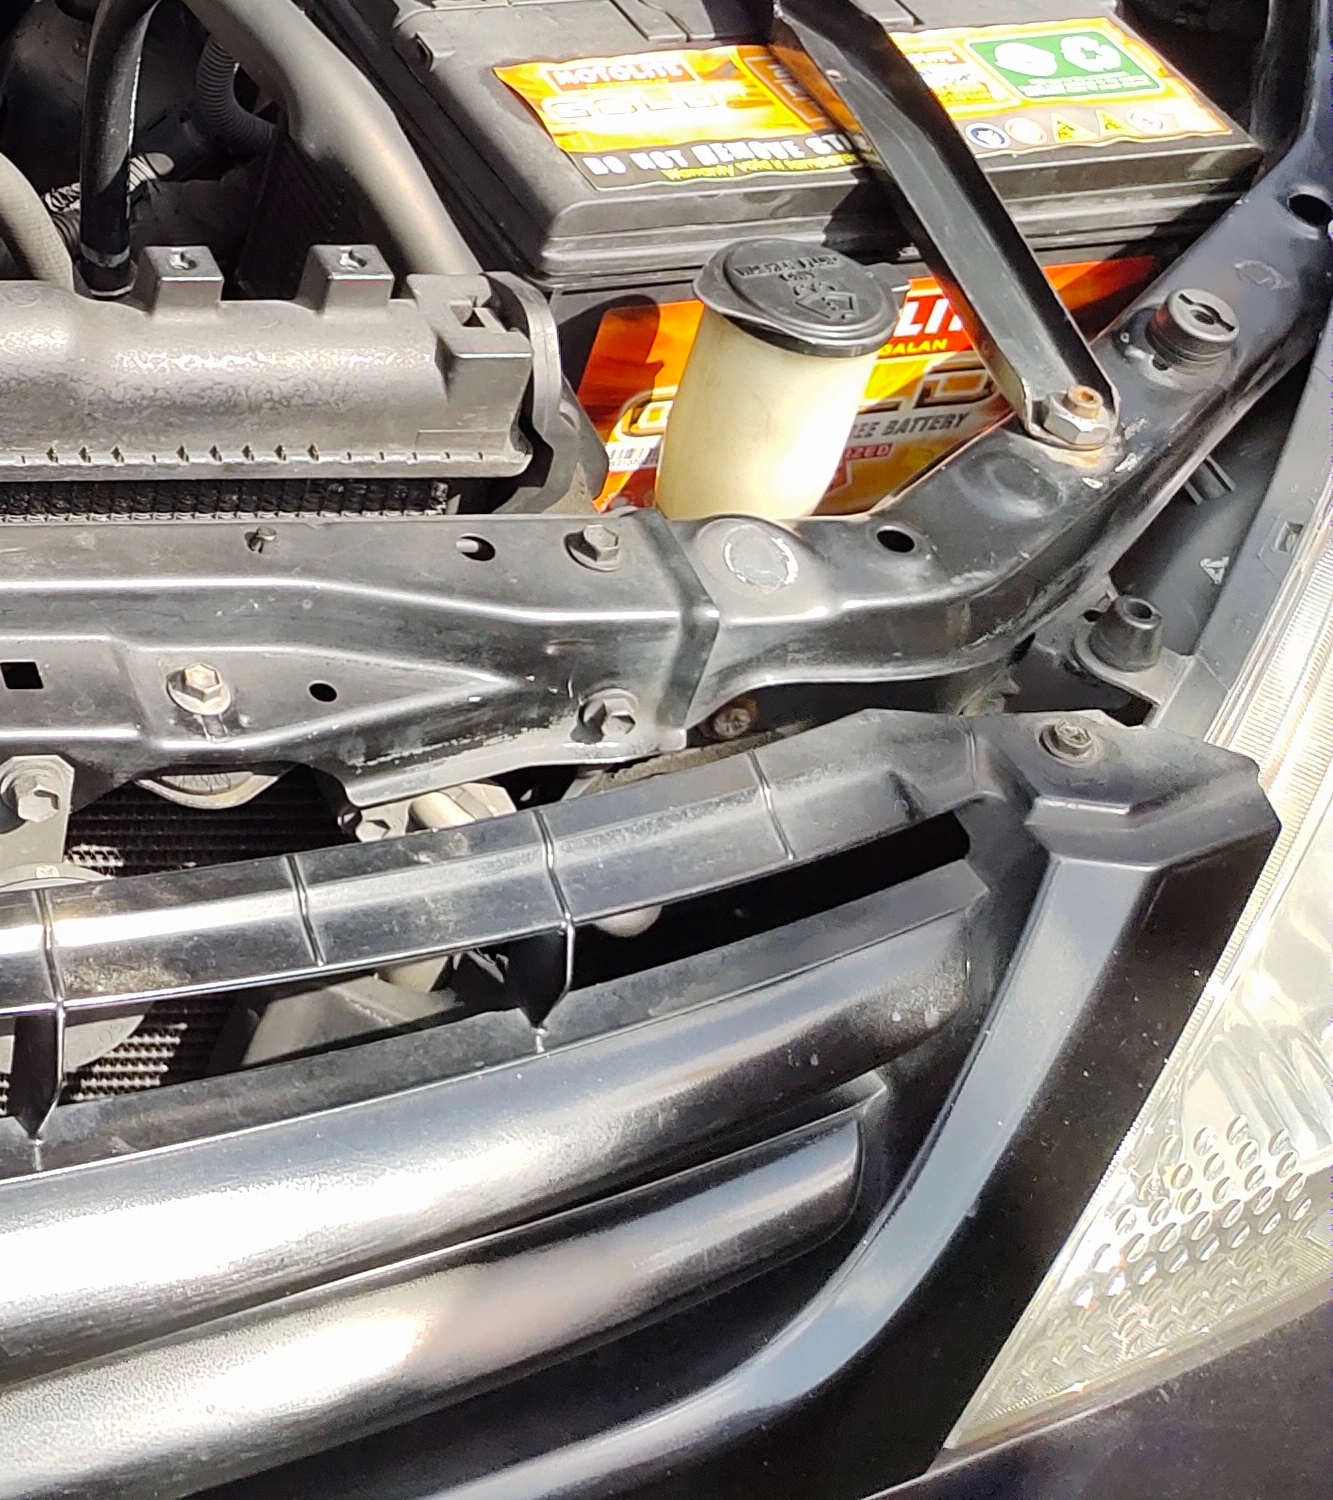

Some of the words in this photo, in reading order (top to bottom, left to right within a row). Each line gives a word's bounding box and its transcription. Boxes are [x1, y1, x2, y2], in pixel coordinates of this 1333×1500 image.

[556, 61, 684, 86] MOTOLITE
[582, 156, 626, 176] DO
[630, 149, 688, 171] NOT
[691, 138, 806, 167] REMOVE
[882, 412, 969, 436] BATTERY
